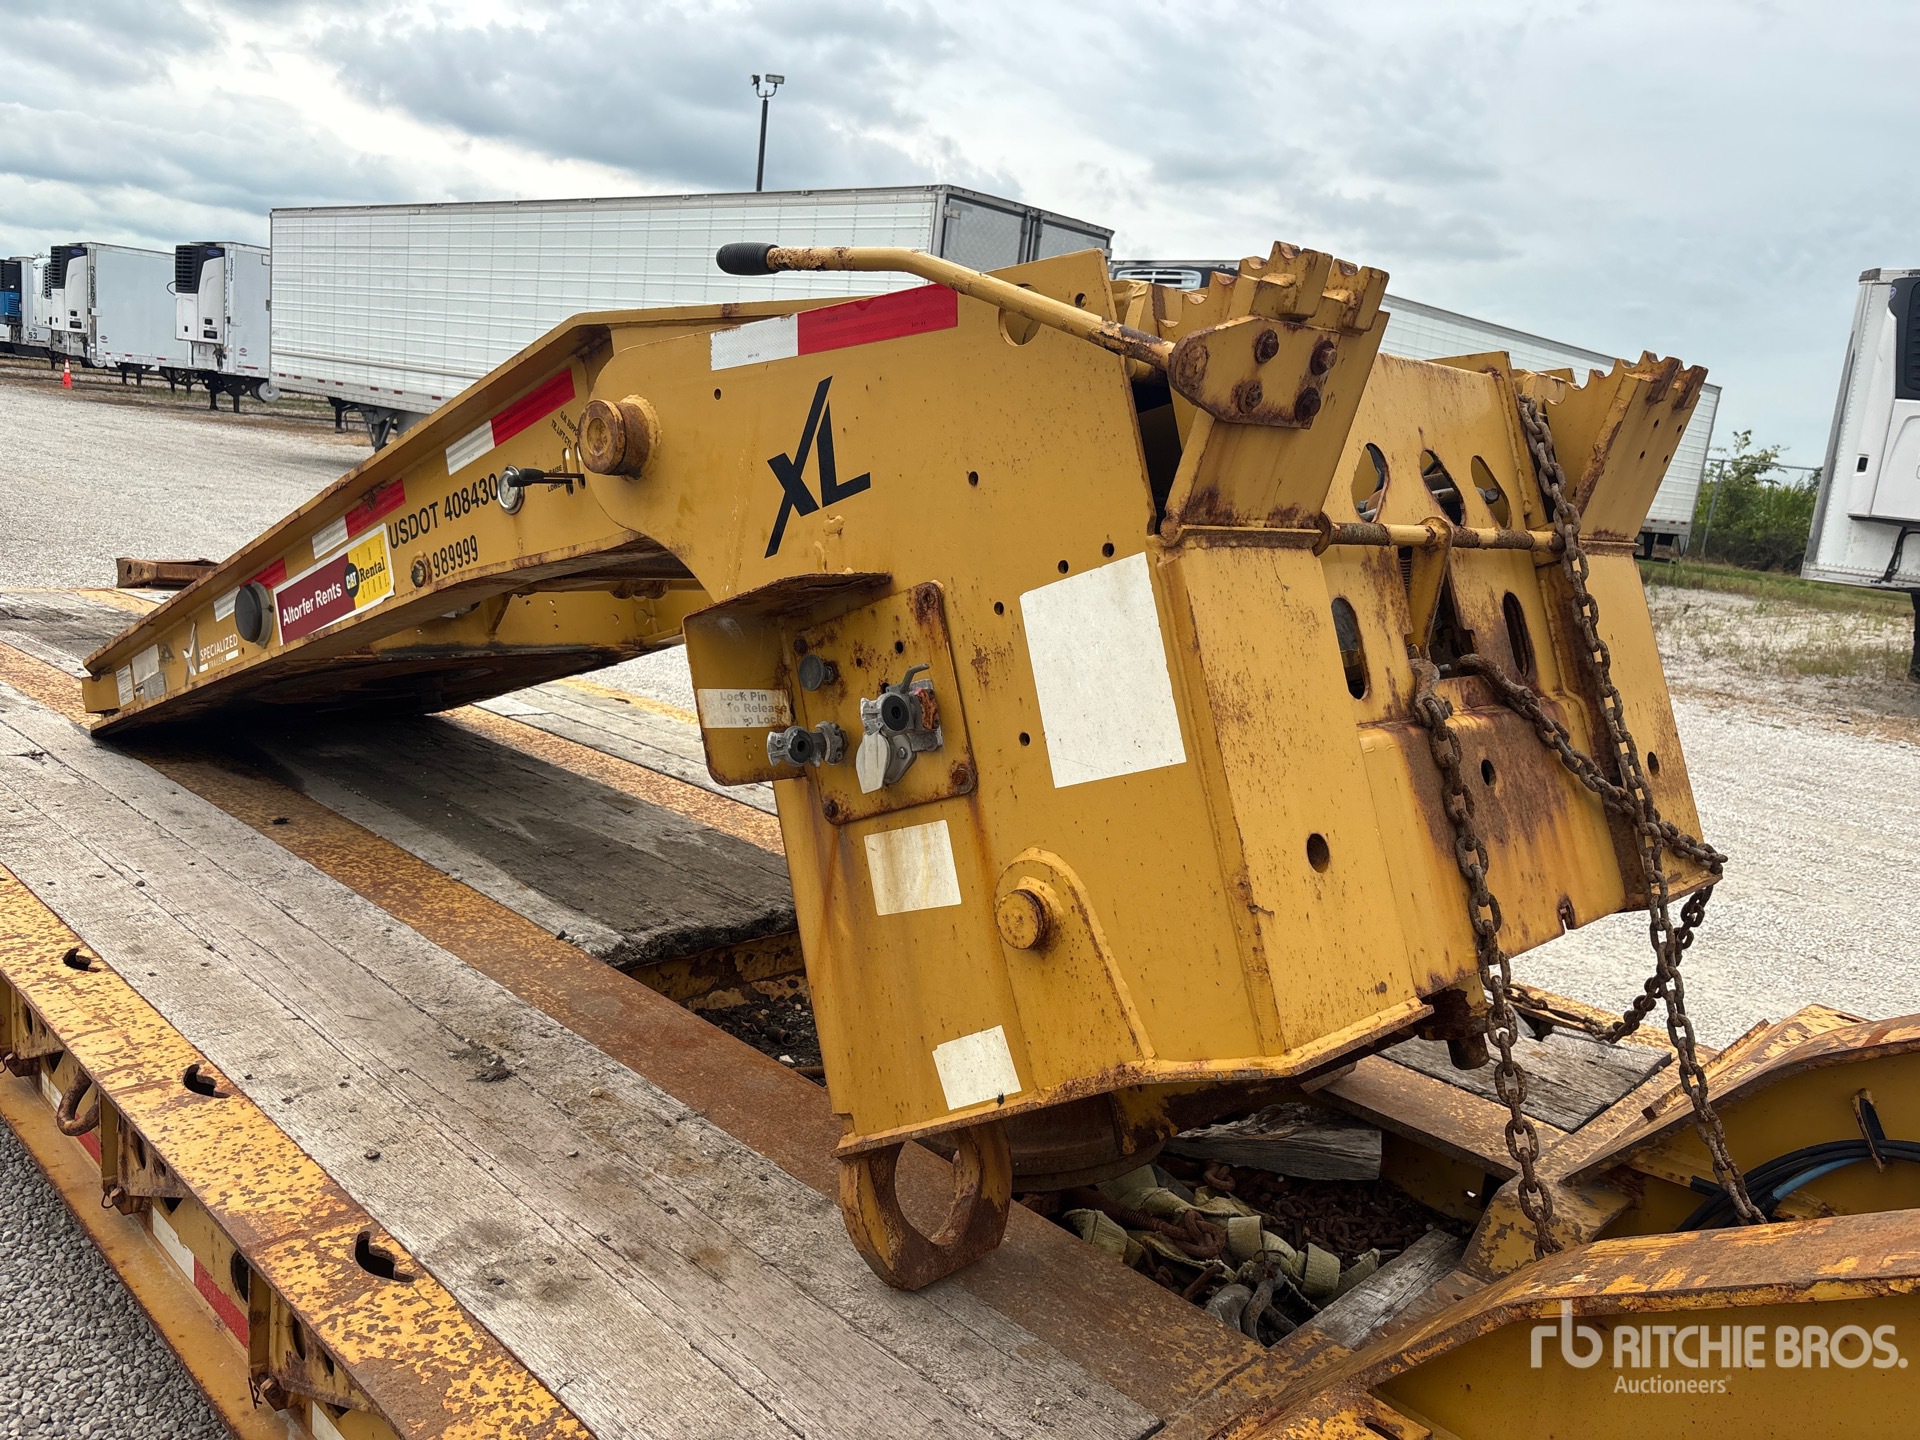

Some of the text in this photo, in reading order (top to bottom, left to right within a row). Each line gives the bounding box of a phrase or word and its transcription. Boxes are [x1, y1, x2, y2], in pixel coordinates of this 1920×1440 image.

[28, 331, 38, 340] 53
[764, 375, 871, 559] XL
[388, 472, 499, 549] USDOT 408430
[432, 534, 479, 578] 989999
[345, 555, 386, 590] CAT Rental
[282, 582, 343, 627] Altorfer Rents
[200, 633, 239, 661] SPECIALIZED
[720, 691, 768, 702] Lock Pin
[743, 702, 788, 714] Release
[756, 714, 785, 726] Lock
